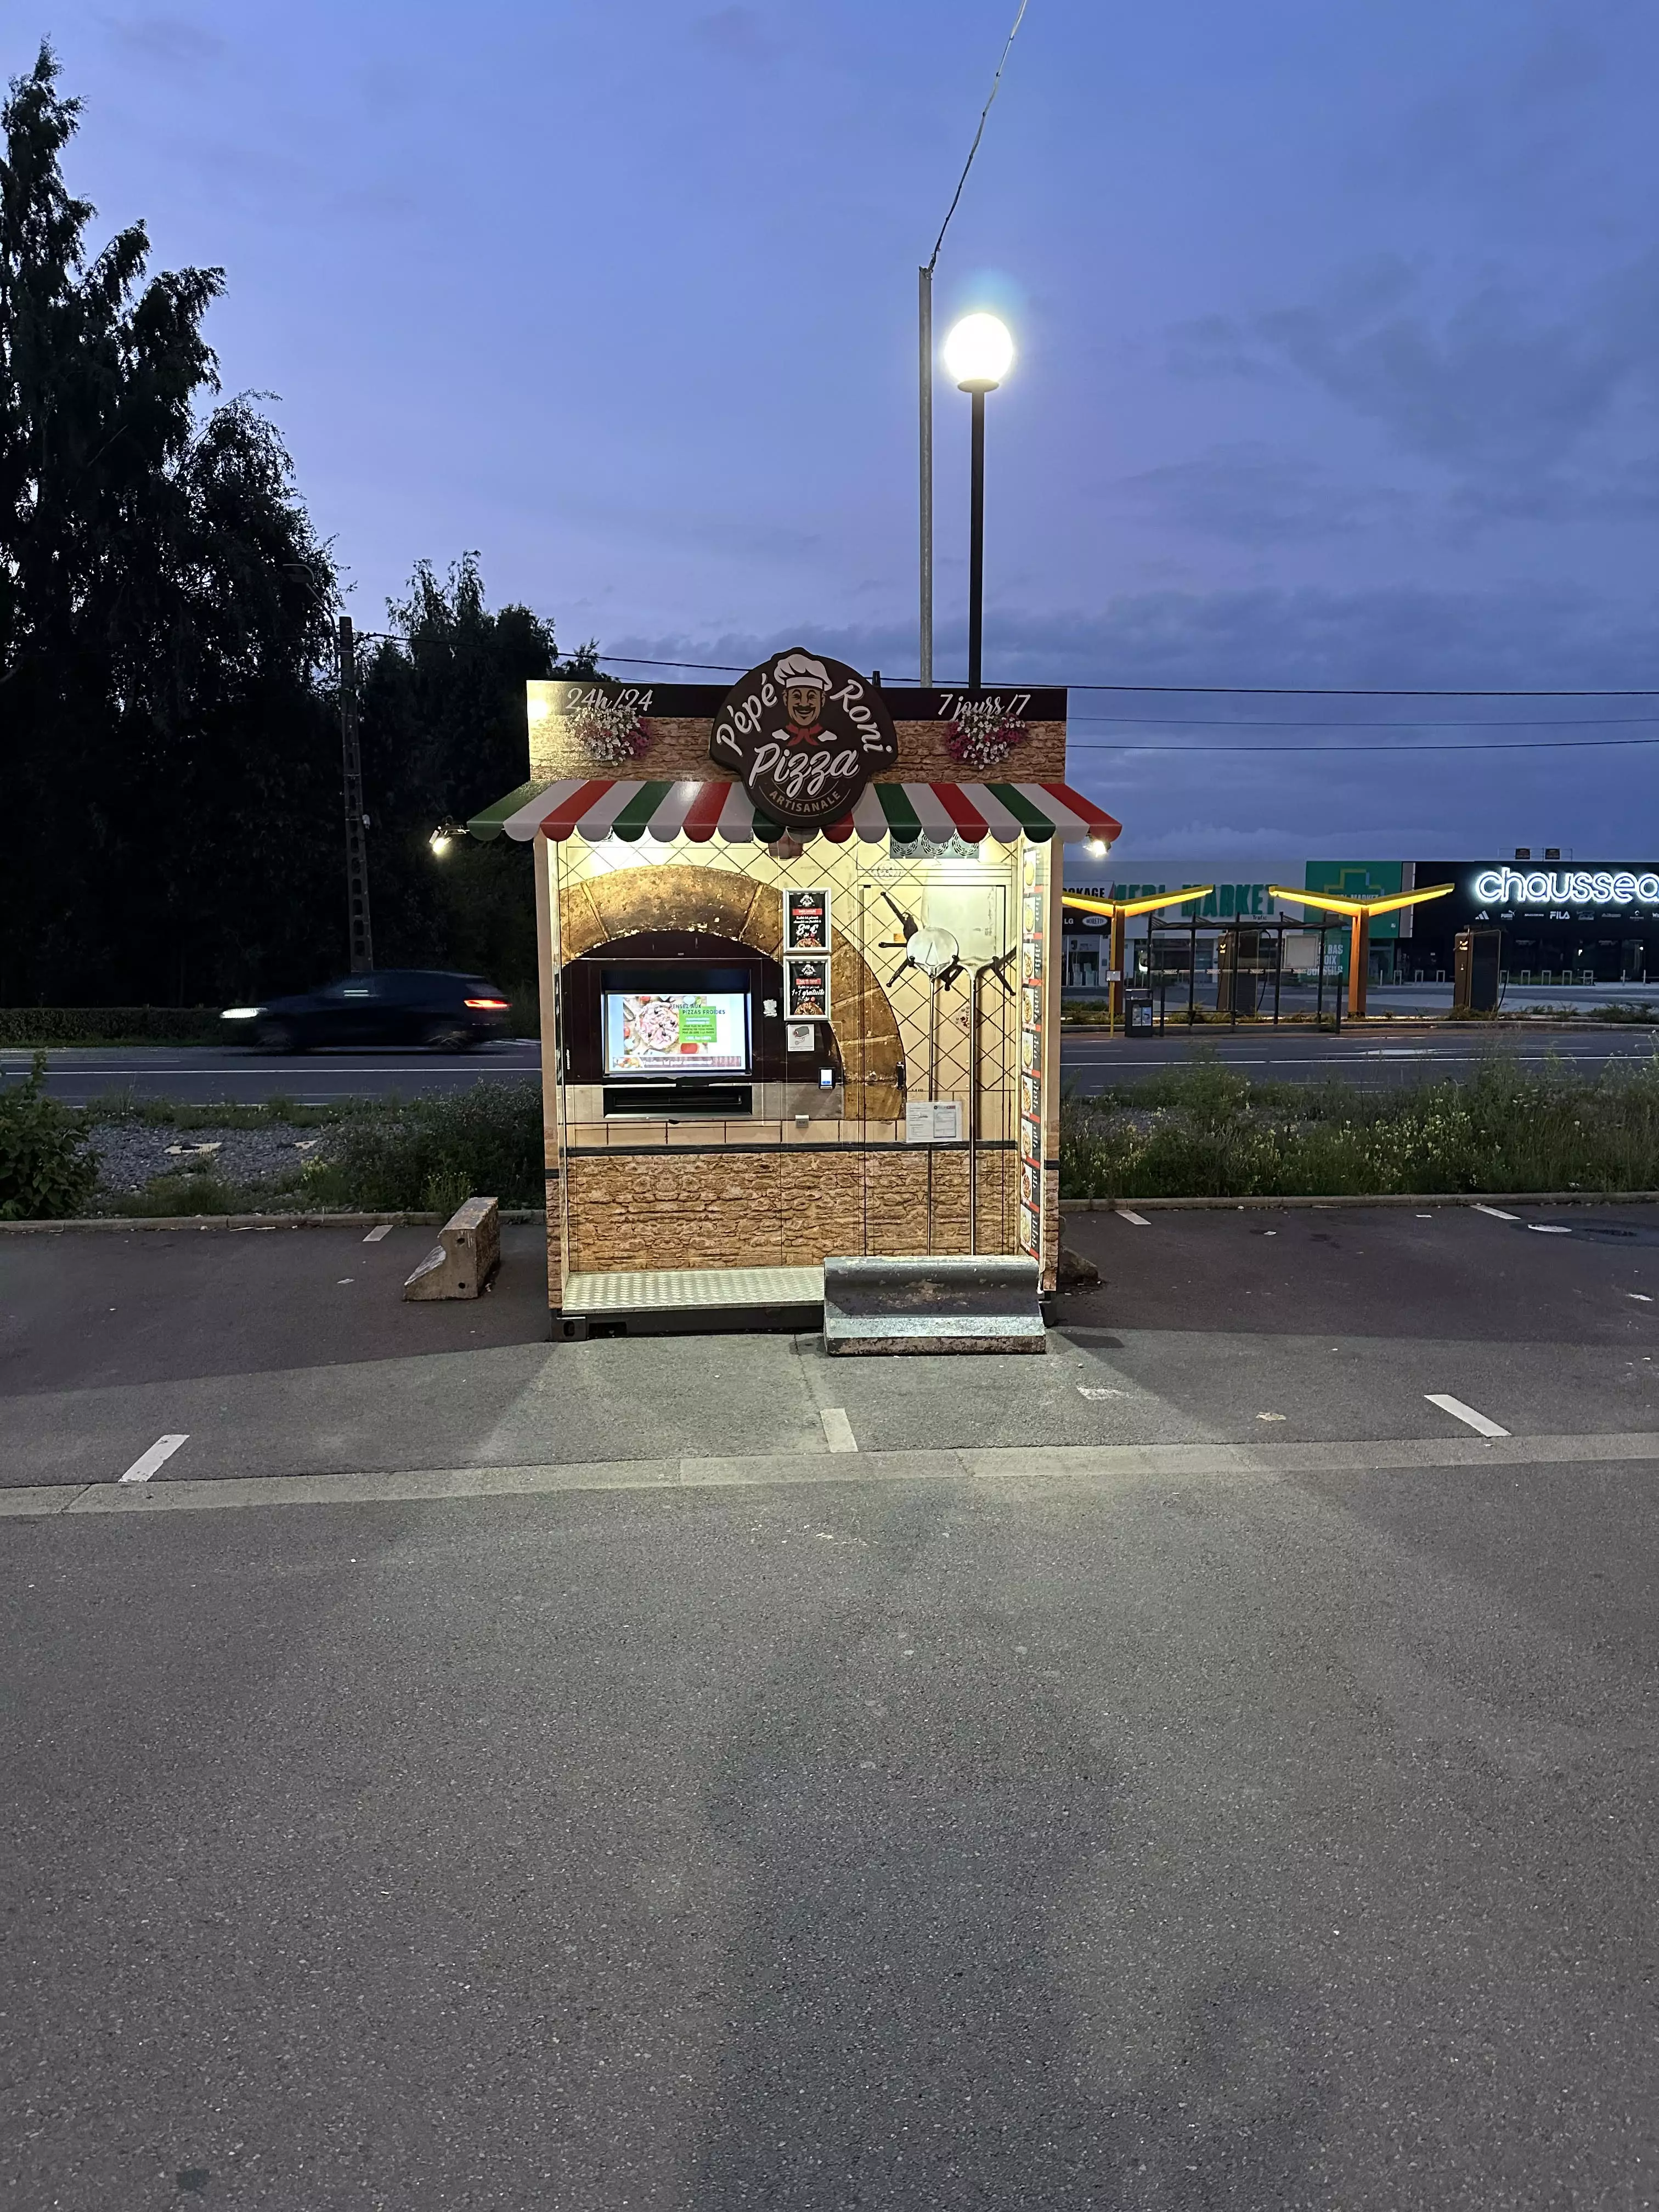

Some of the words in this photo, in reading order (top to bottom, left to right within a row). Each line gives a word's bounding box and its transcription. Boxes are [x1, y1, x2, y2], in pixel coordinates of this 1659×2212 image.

[716, 673, 777, 757] Pépé
[830, 679, 893, 753] Roni
[748, 742, 859, 798] Pizza
[769, 790, 841, 812] ARTISANALE
[1063, 888, 1105, 898] KAGE
[1476, 866, 1659, 904] chaussea
[1181, 883, 1275, 917] MARKET
[1549, 911, 1570, 919] FILA
[1328, 944, 1344, 955] BAS
